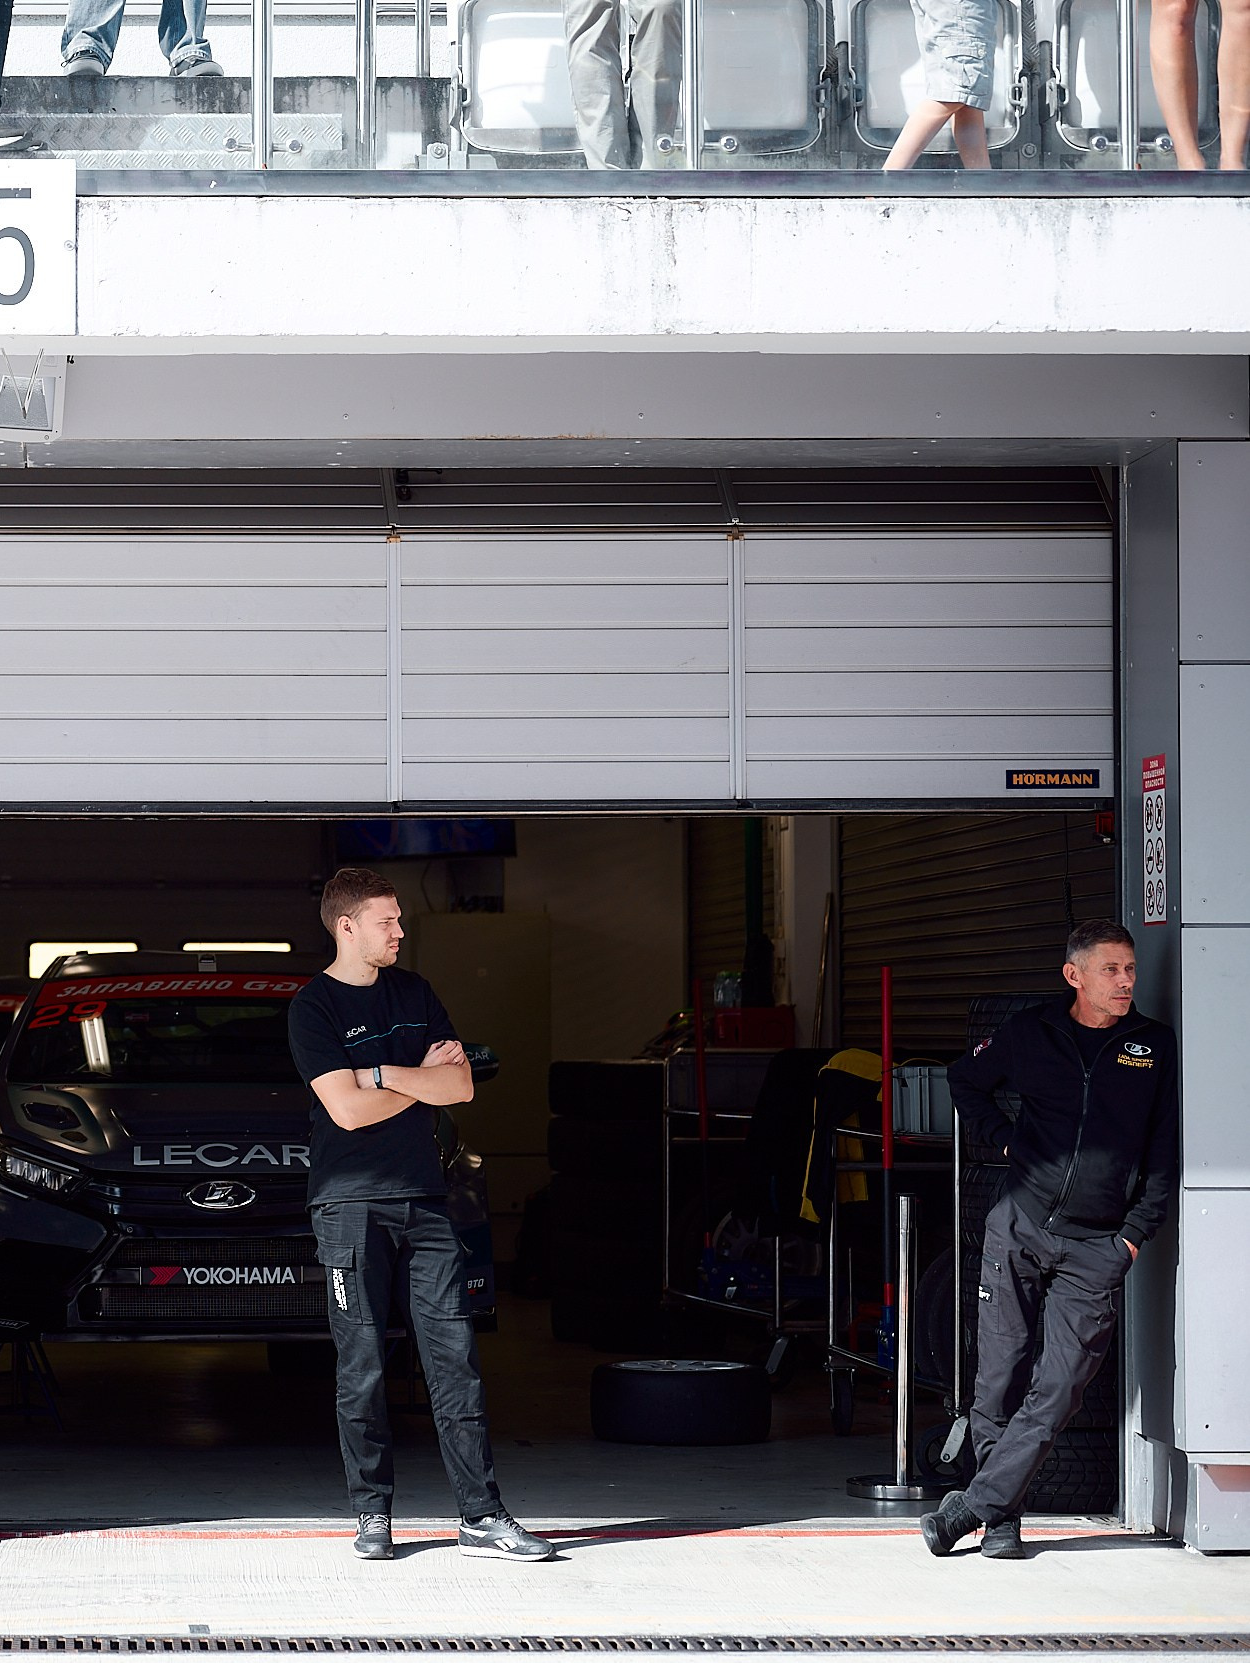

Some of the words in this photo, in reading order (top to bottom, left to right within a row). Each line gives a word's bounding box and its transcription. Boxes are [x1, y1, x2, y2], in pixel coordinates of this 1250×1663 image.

[1012, 772, 1093, 785] HÖRMANN
[56, 980, 233, 998] ЗАПРАВЛЕНО
[28, 1001, 107, 1029] 29
[345, 1025, 368, 1039] LECAR
[133, 1143, 311, 1168] LECAR
[182, 1267, 296, 1285] YOKOHAMA
